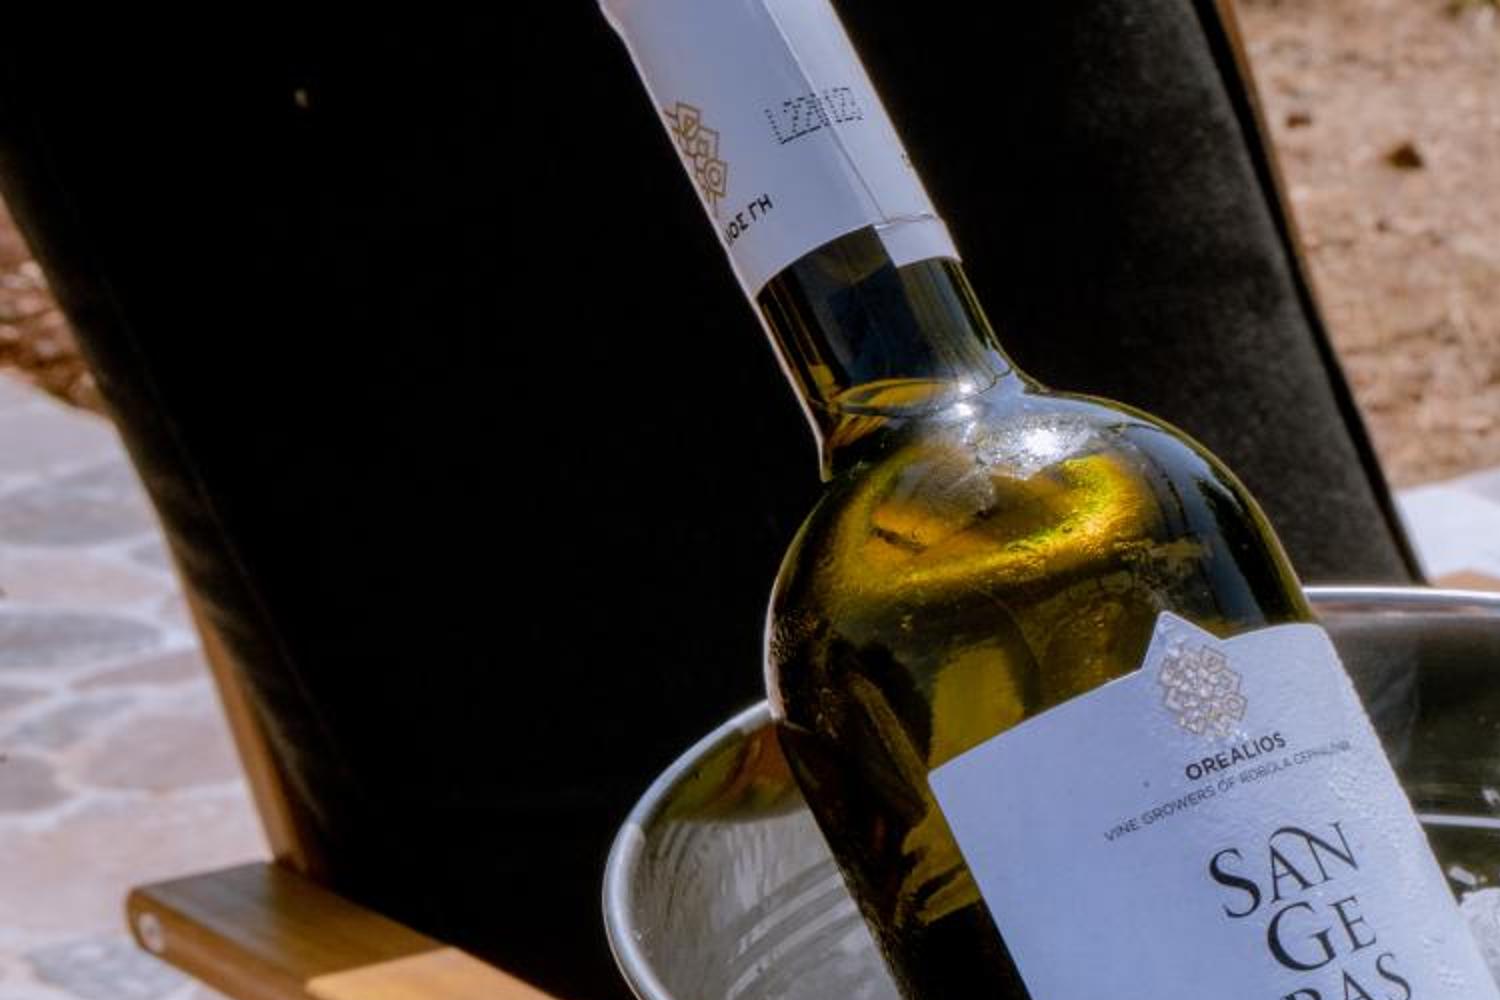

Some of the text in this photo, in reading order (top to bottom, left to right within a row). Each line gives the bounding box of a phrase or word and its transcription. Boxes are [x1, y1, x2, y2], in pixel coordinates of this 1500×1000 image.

[1185, 732, 1287, 780] OREALIOS
[1103, 817, 1140, 842] VINE
[1141, 785, 1217, 826] GROWERS
[1217, 777, 1236, 794] OF
[1208, 822, 1359, 919] SAN
[1267, 896, 1377, 972] GE
